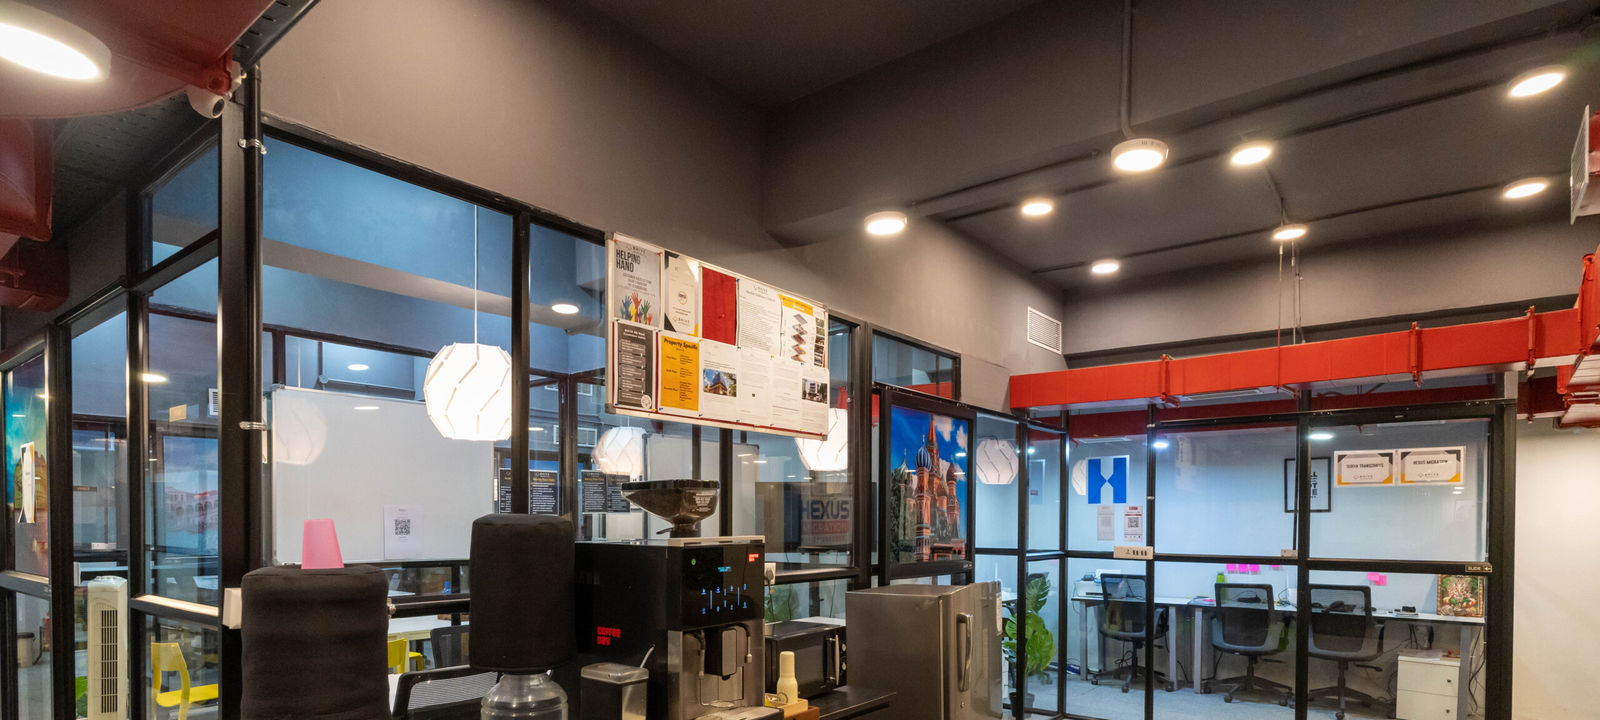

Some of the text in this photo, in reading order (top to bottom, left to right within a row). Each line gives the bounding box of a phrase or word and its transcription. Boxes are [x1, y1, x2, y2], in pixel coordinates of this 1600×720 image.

[616, 248, 641, 265] HELPING
[616, 258, 634, 273] HAND
[663, 337, 683, 348] Property
[800, 500, 849, 520] HEXUS
